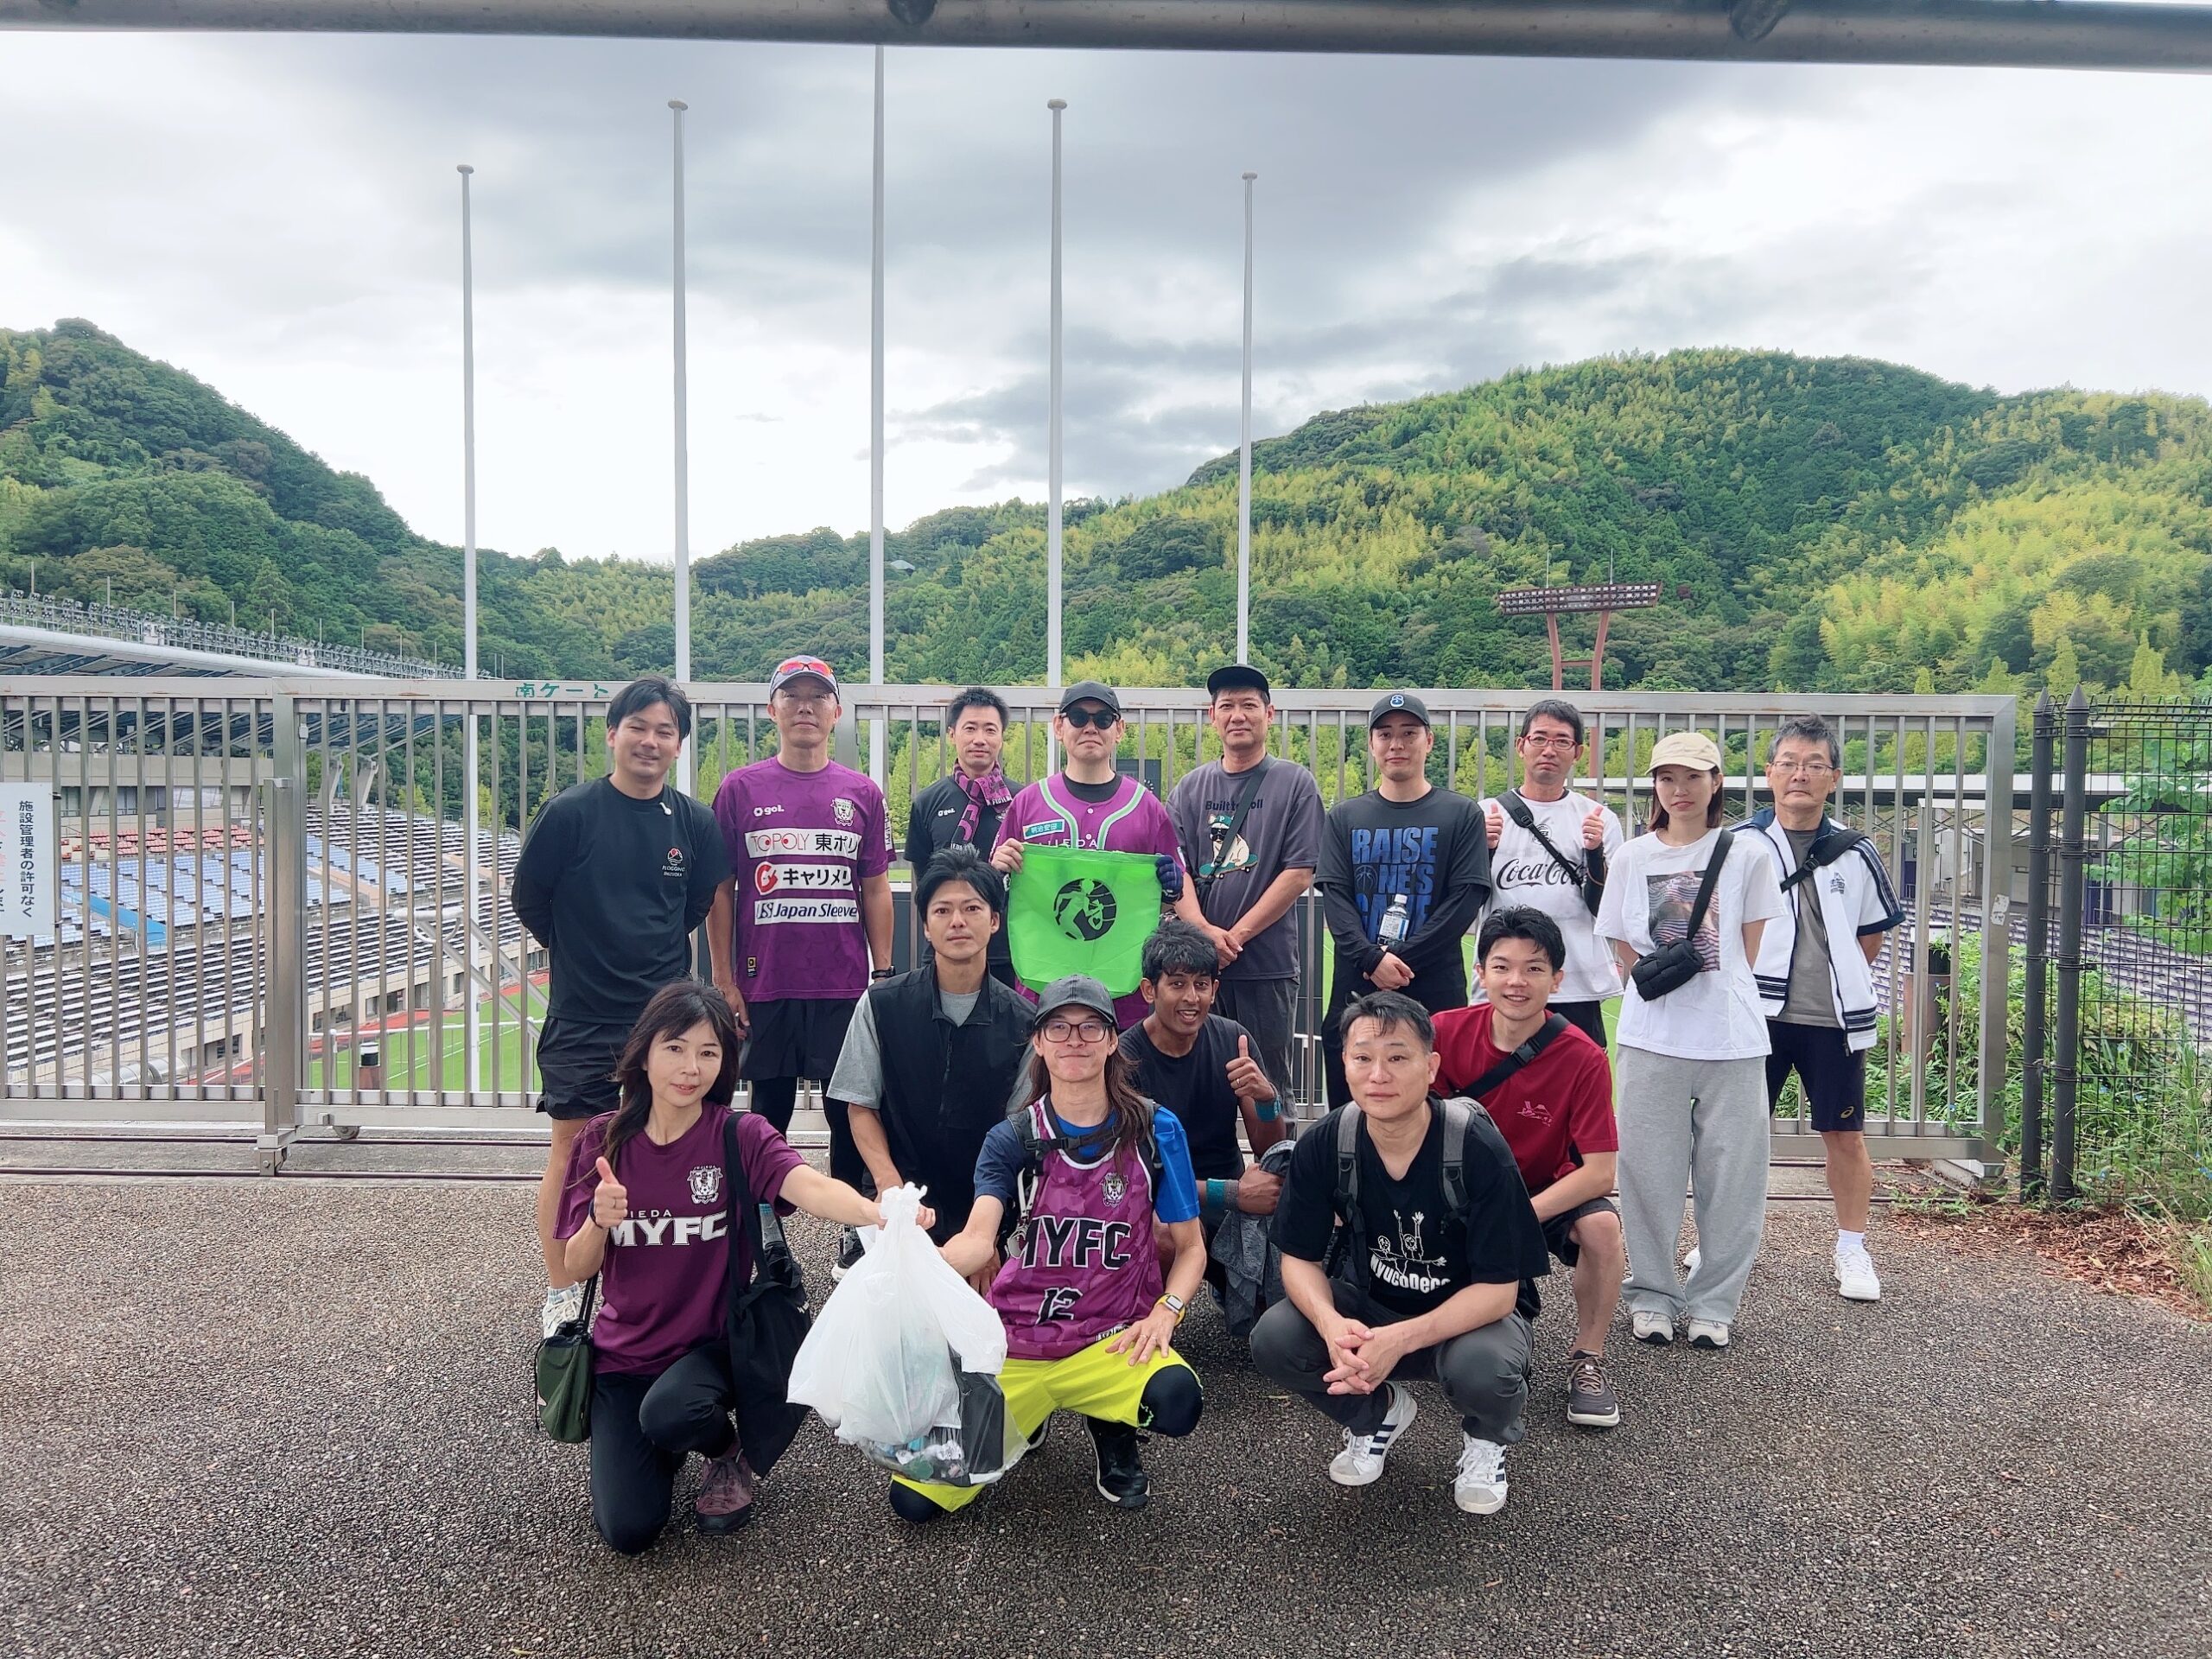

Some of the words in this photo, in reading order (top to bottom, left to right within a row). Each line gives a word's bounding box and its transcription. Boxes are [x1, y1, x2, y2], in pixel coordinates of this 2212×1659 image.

[1205, 800, 1230, 810] Built
[751, 833, 810, 852] TOPOLY
[815, 833, 858, 854] 東ポリ
[1351, 826, 1439, 864] RAISE
[19, 800, 35, 918] 施設管理者の許可なく
[783, 868, 852, 887] キャリメリ
[773, 904, 817, 919] Japan
[818, 904, 858, 918] Sleeve
[630, 1210, 672, 1218] IEDA
[610, 1210, 728, 1247] MYFC
[1037, 1287, 1084, 1325] 12
